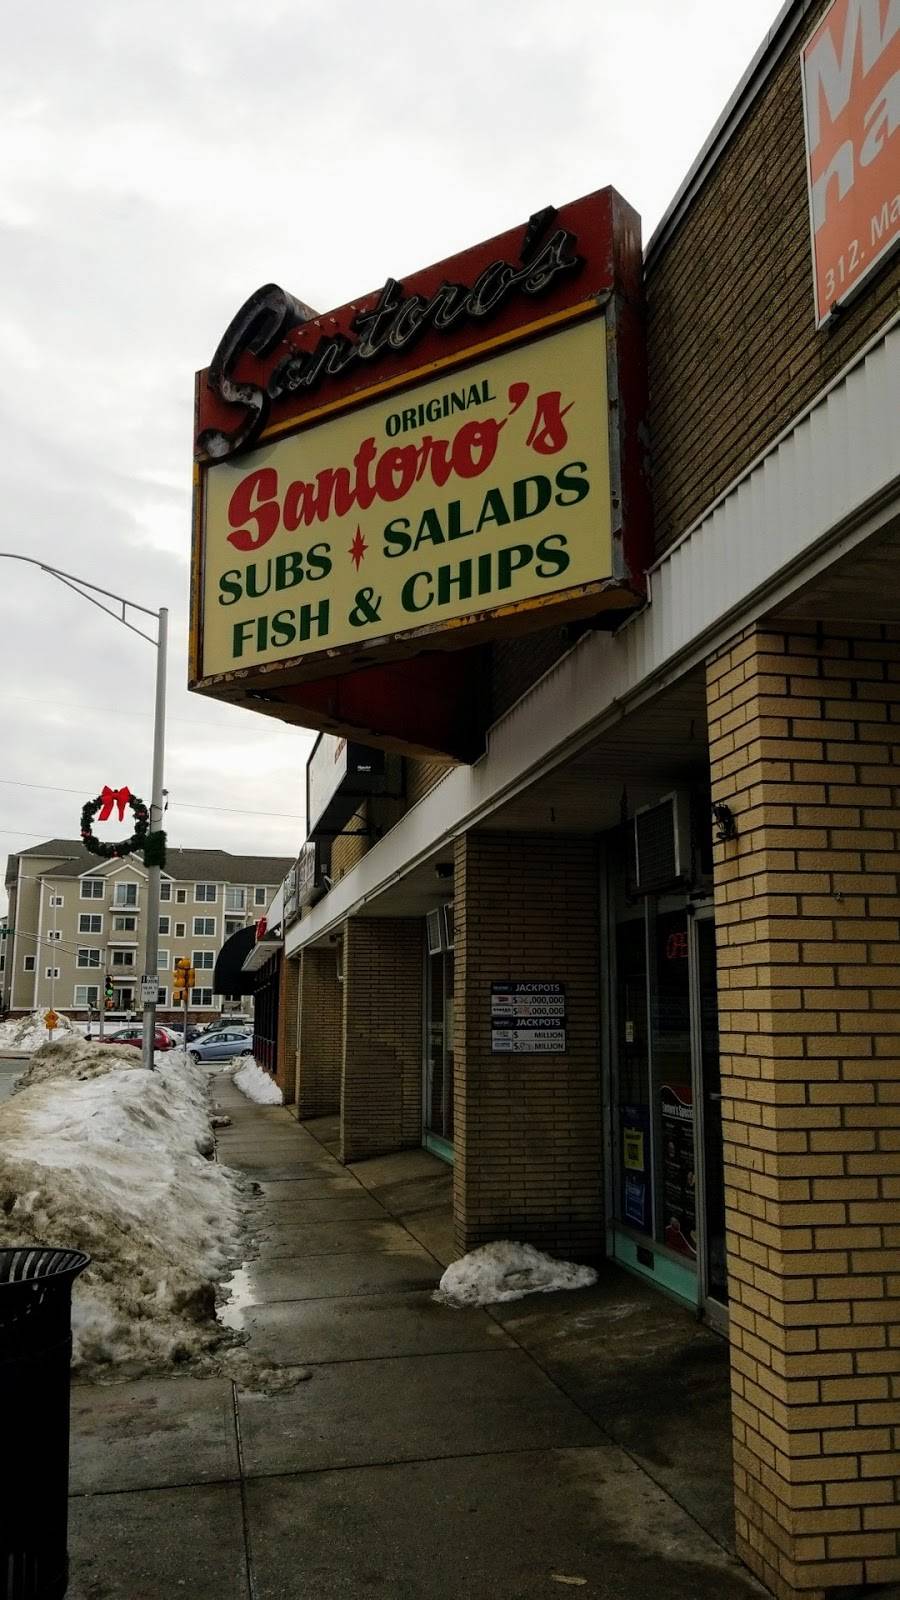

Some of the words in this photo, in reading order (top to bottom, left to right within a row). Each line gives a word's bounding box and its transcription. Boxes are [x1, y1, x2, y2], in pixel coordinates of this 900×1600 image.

[197, 206, 585, 466] Santoro's
[385, 379, 497, 438] ORIGINAL
[227, 382, 575, 552] Santoro's
[218, 542, 333, 606] SUBS
[383, 461, 590, 559] SALADS
[232, 599, 330, 658] FISH
[348, 586, 382, 628] &
[401, 533, 571, 613] CHIPS
[515, 984, 560, 992] JACKPOTS
[516, 1019, 561, 1027] JACKPOTS
[534, 1031, 563, 1039] MILLION
[534, 1042, 563, 1050] MILLION
